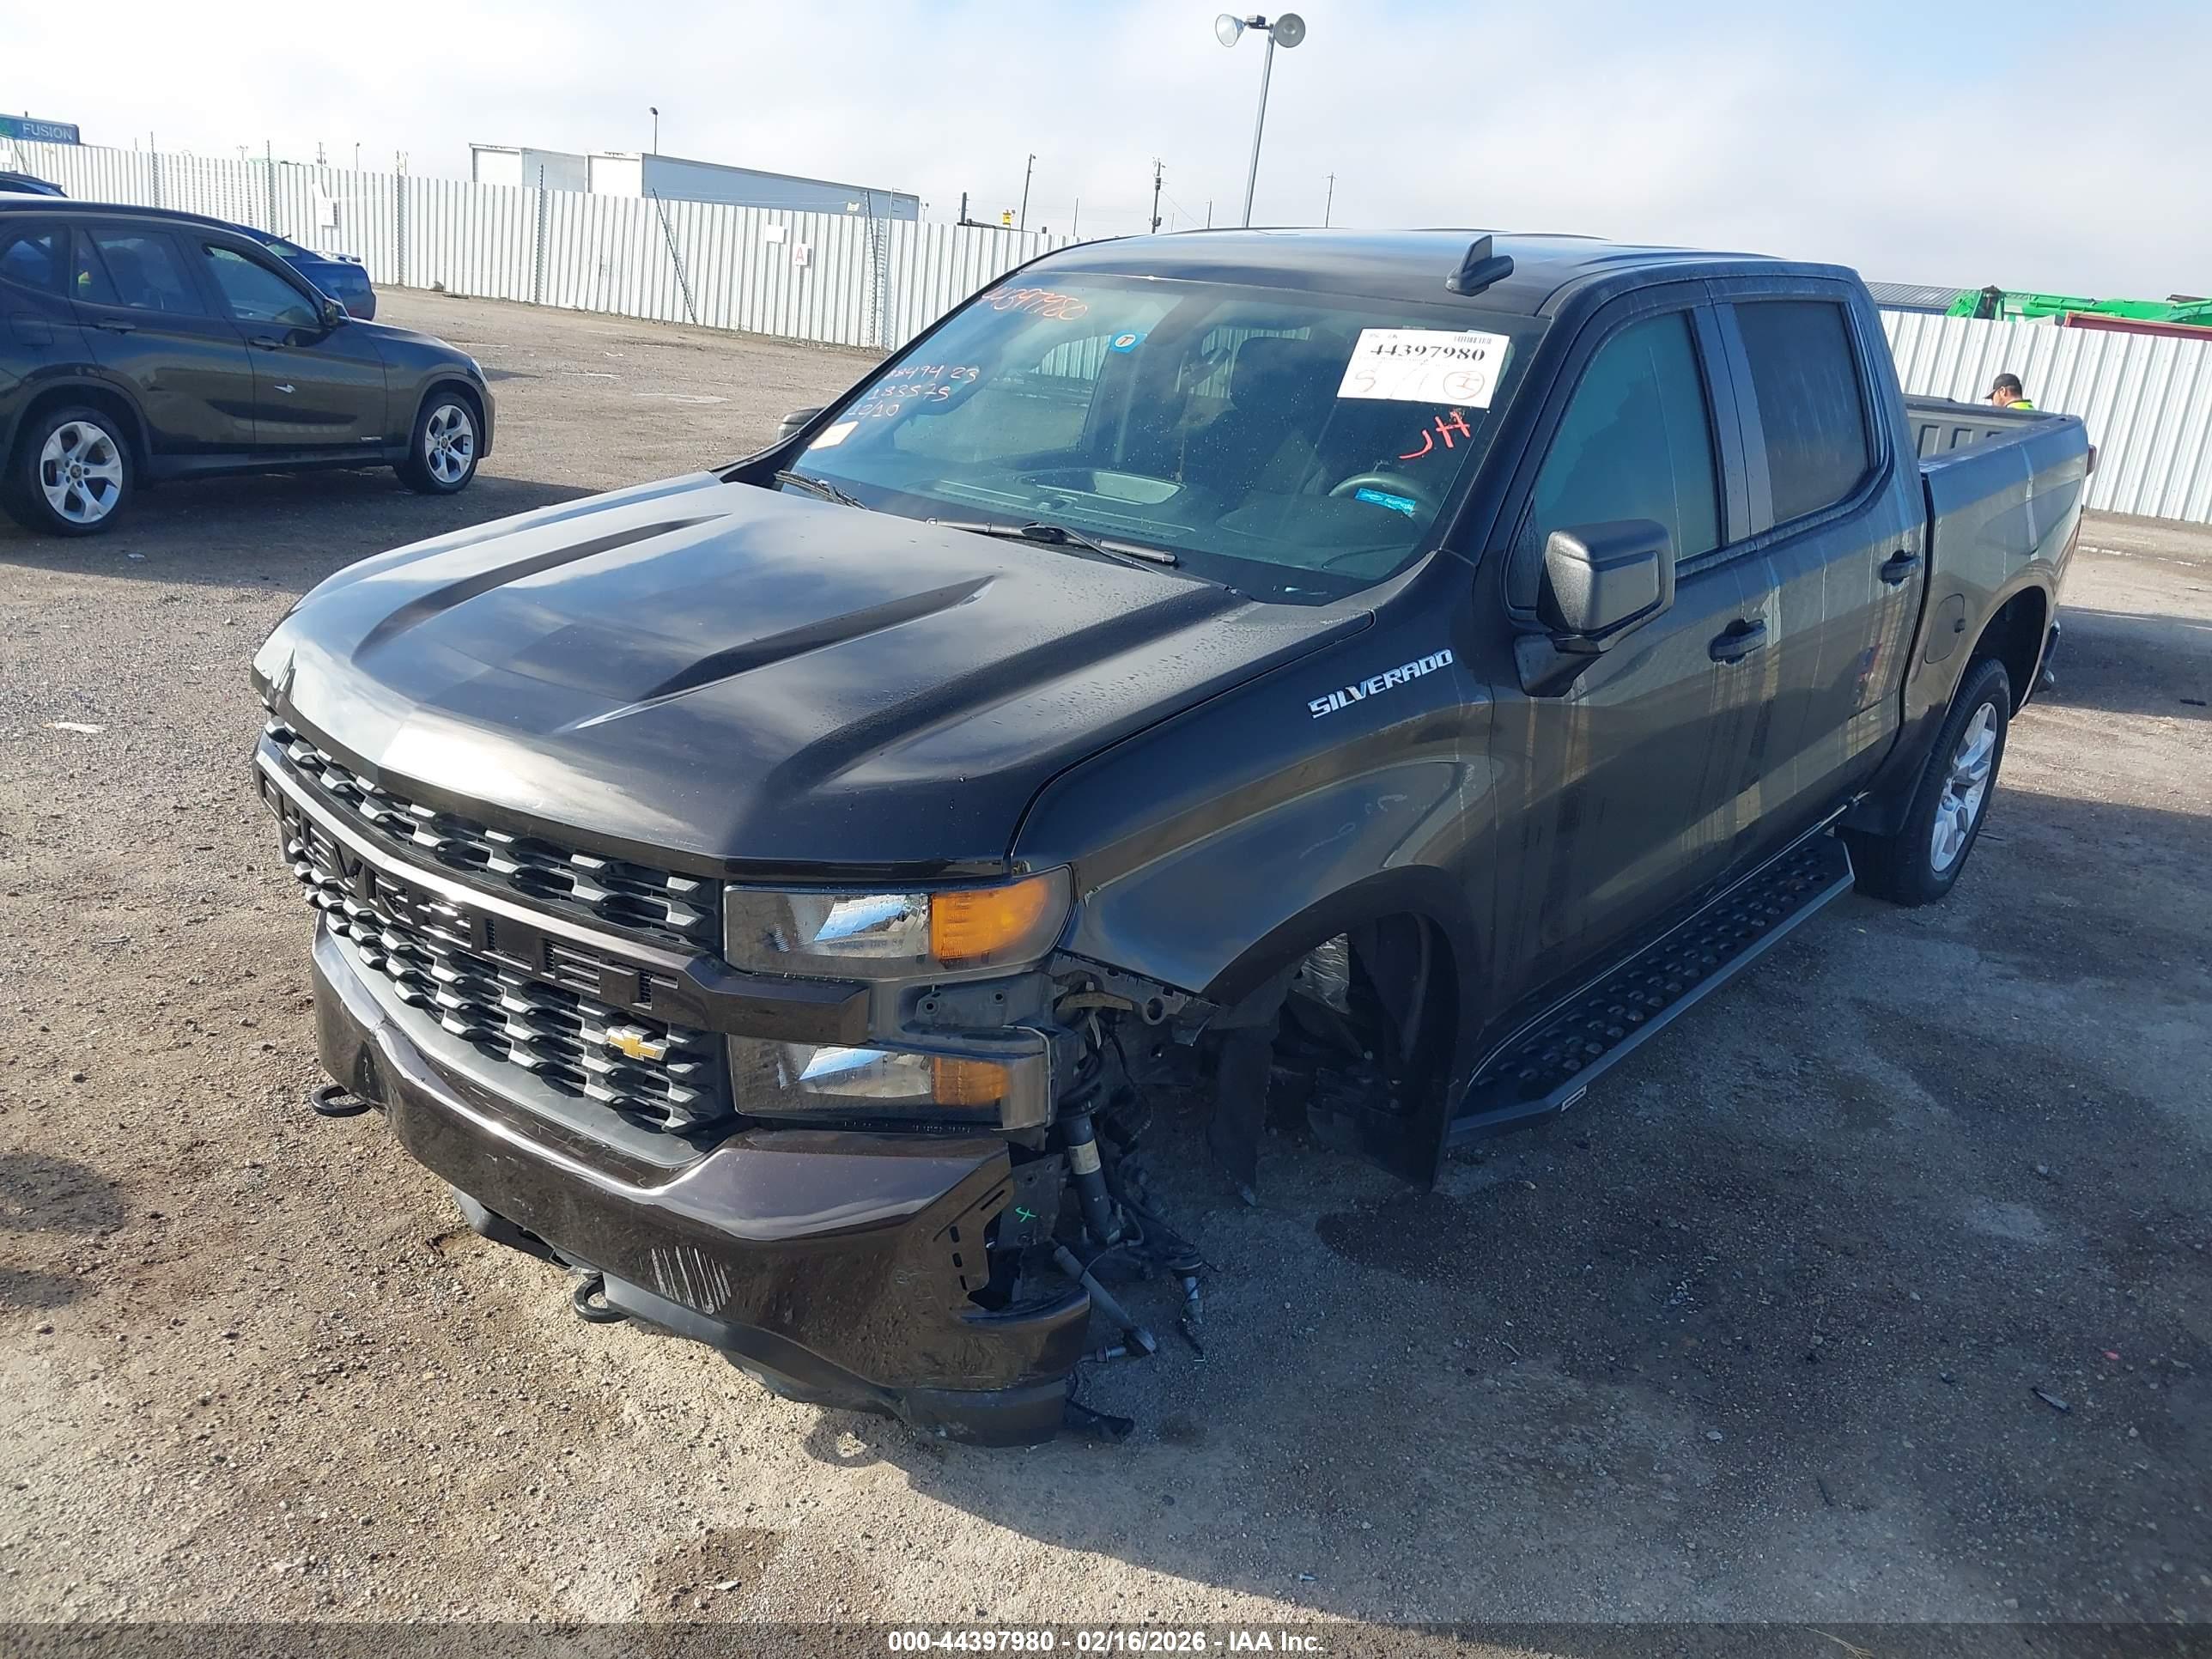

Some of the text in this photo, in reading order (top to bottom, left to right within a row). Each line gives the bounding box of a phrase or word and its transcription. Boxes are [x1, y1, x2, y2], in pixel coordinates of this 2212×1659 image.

[22, 123, 72, 140] FUSION
[1370, 343, 1486, 362] 44397980
[1307, 648, 1454, 719] SILVERADO
[259, 770, 679, 1012] CHEVROLET
